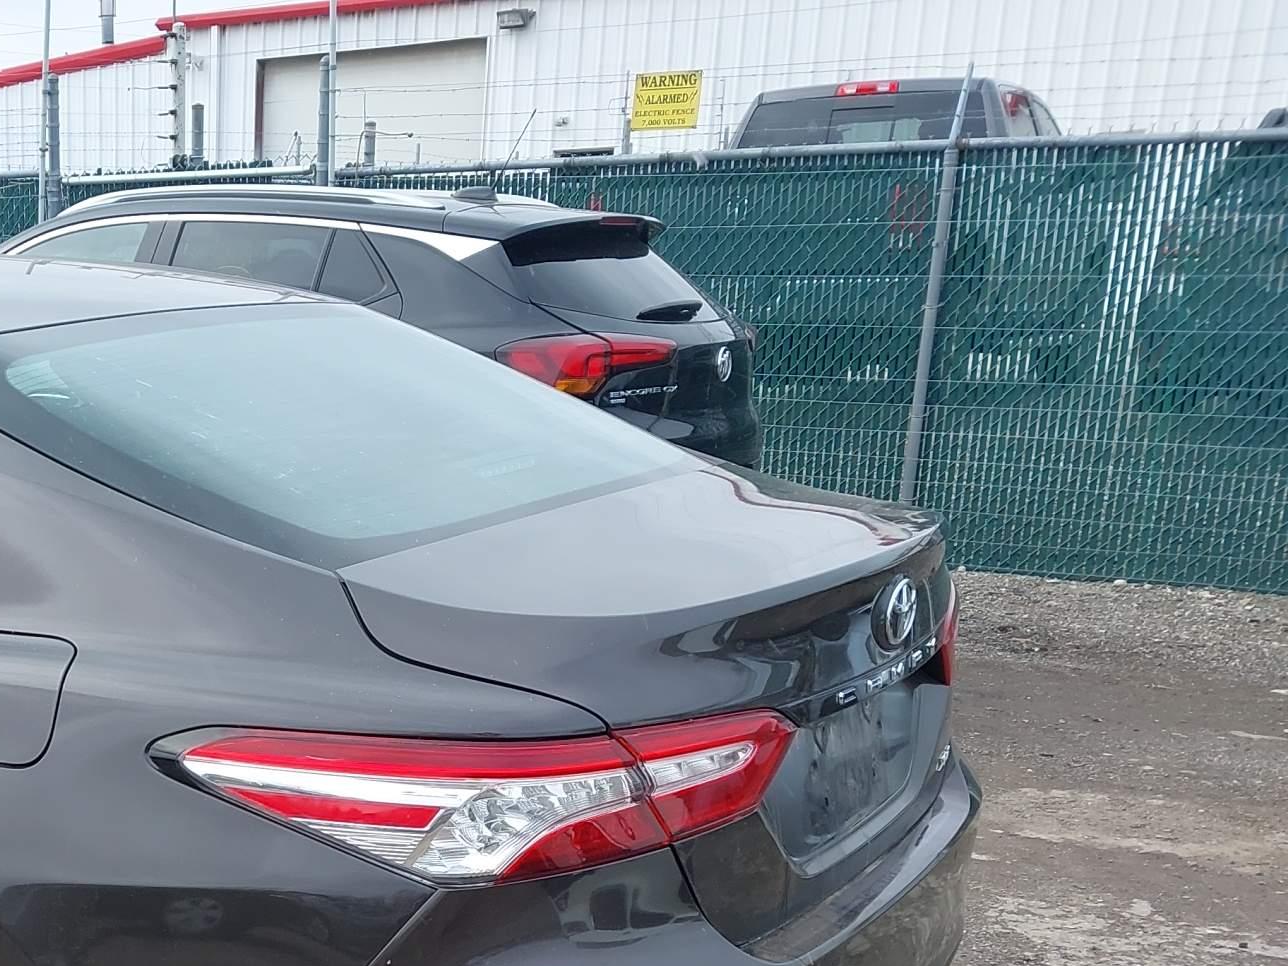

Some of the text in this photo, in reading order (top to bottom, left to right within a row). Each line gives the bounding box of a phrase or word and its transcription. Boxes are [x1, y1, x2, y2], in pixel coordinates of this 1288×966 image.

[640, 74, 698, 88] WARNING
[644, 93, 689, 105] ALARMED
[635, 109, 670, 117] ELECTRIC
[642, 119, 661, 127] 7,000
[609, 386, 662, 398] ENCORE
